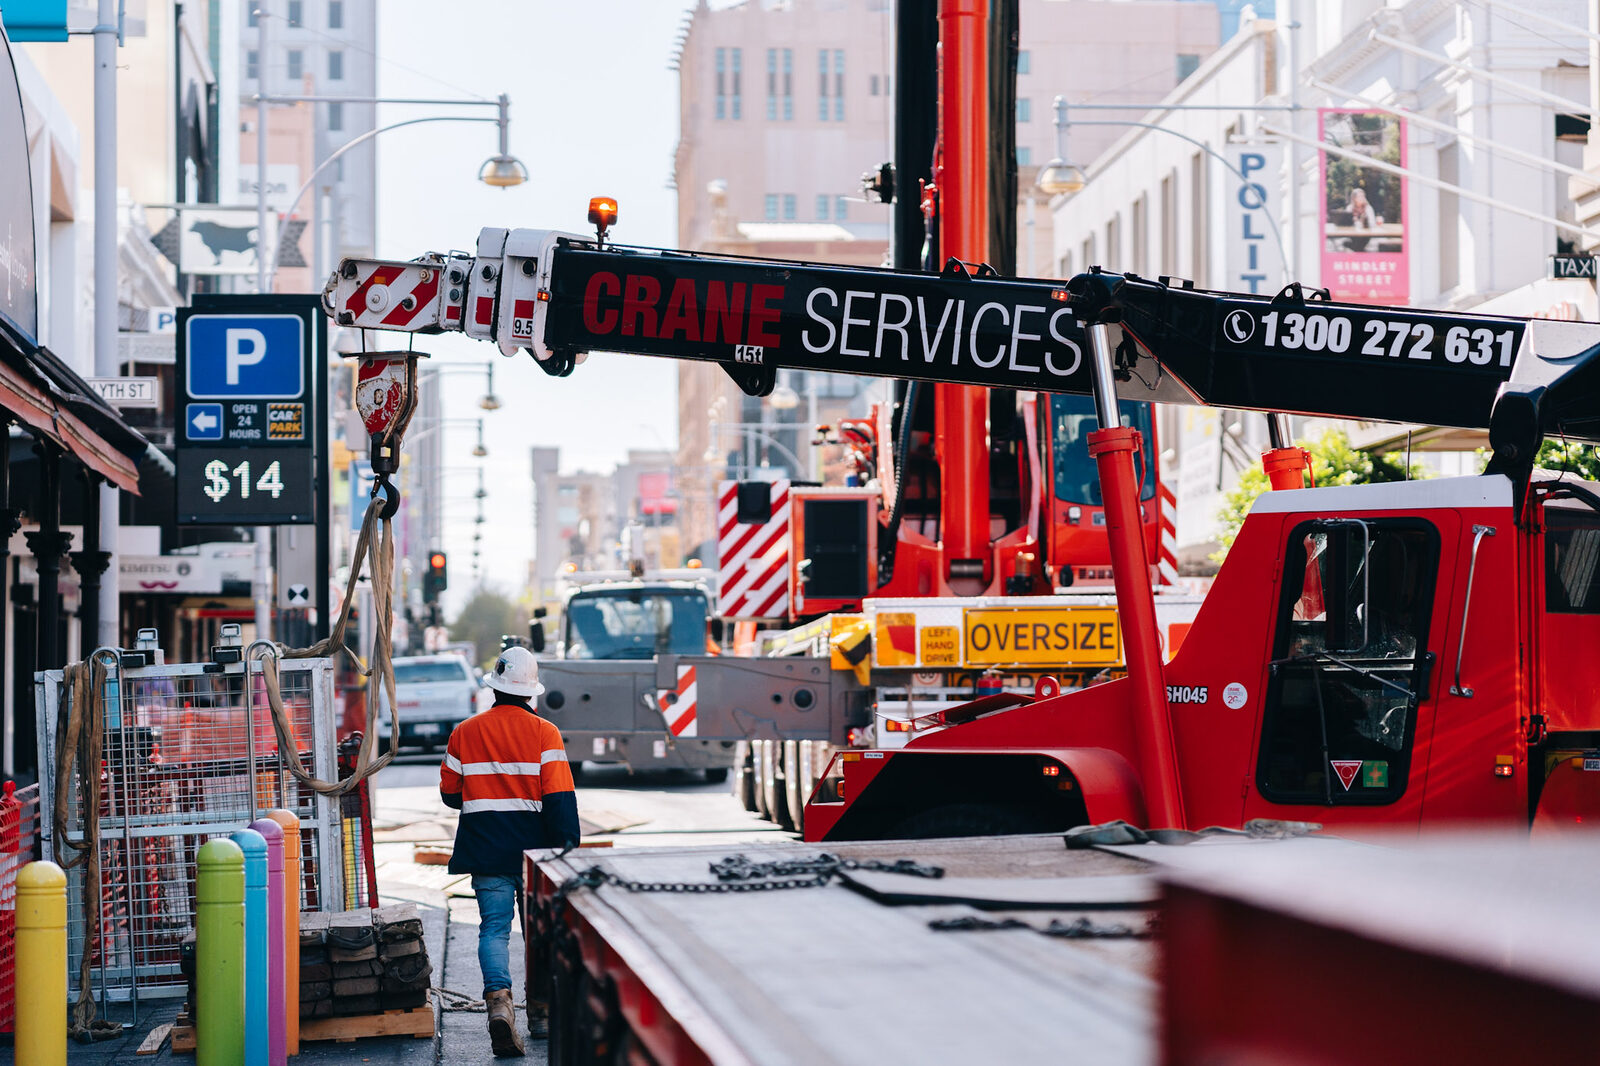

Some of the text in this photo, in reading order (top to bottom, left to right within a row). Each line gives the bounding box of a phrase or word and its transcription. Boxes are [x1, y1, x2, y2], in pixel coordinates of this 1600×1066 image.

[1238, 153, 1267, 293] POLIT
[1333, 261, 1397, 272] HINDLEY
[1555, 257, 1596, 276] TAXI
[1338, 274, 1393, 285] STREET
[158, 313, 175, 329] P
[514, 319, 533, 335] 9.5
[582, 271, 1085, 377] CRANE SERVICES
[1261, 311, 1514, 367] 1300 272 631
[226, 328, 267, 385] P
[737, 345, 763, 363] 15t
[93, 384, 144, 397] YTH ST
[232, 404, 258, 414] OPEN
[237, 415, 252, 426] 24
[270, 422, 302, 432] PARK
[229, 429, 261, 439] HOURS
[203, 459, 285, 502] $14
[927, 628, 952, 637] LEFT
[971, 622, 1115, 651] OVERSIZE
[926, 641, 954, 650] HAND
[926, 654, 954, 663] DRIVE
